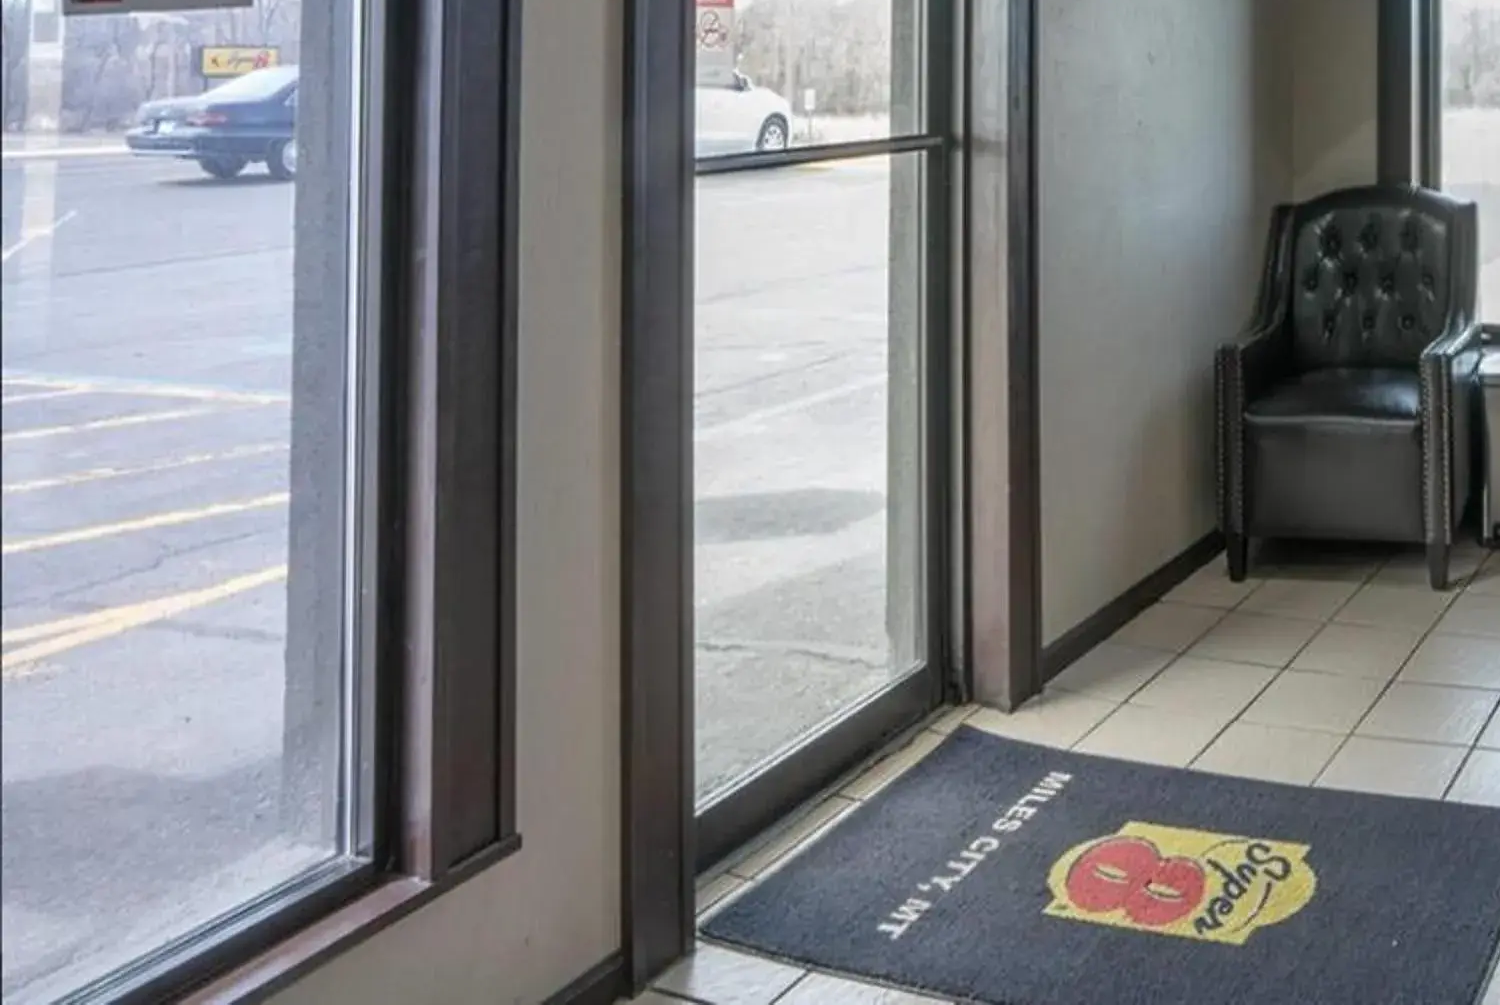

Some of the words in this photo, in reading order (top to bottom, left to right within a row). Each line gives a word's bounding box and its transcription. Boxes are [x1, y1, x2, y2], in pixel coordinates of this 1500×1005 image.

[992, 771, 1073, 833] MILES
[917, 836, 999, 891] CITY,
[1065, 835, 1206, 927] 8
[1194, 842, 1291, 935] Super
[877, 898, 932, 940] MT
